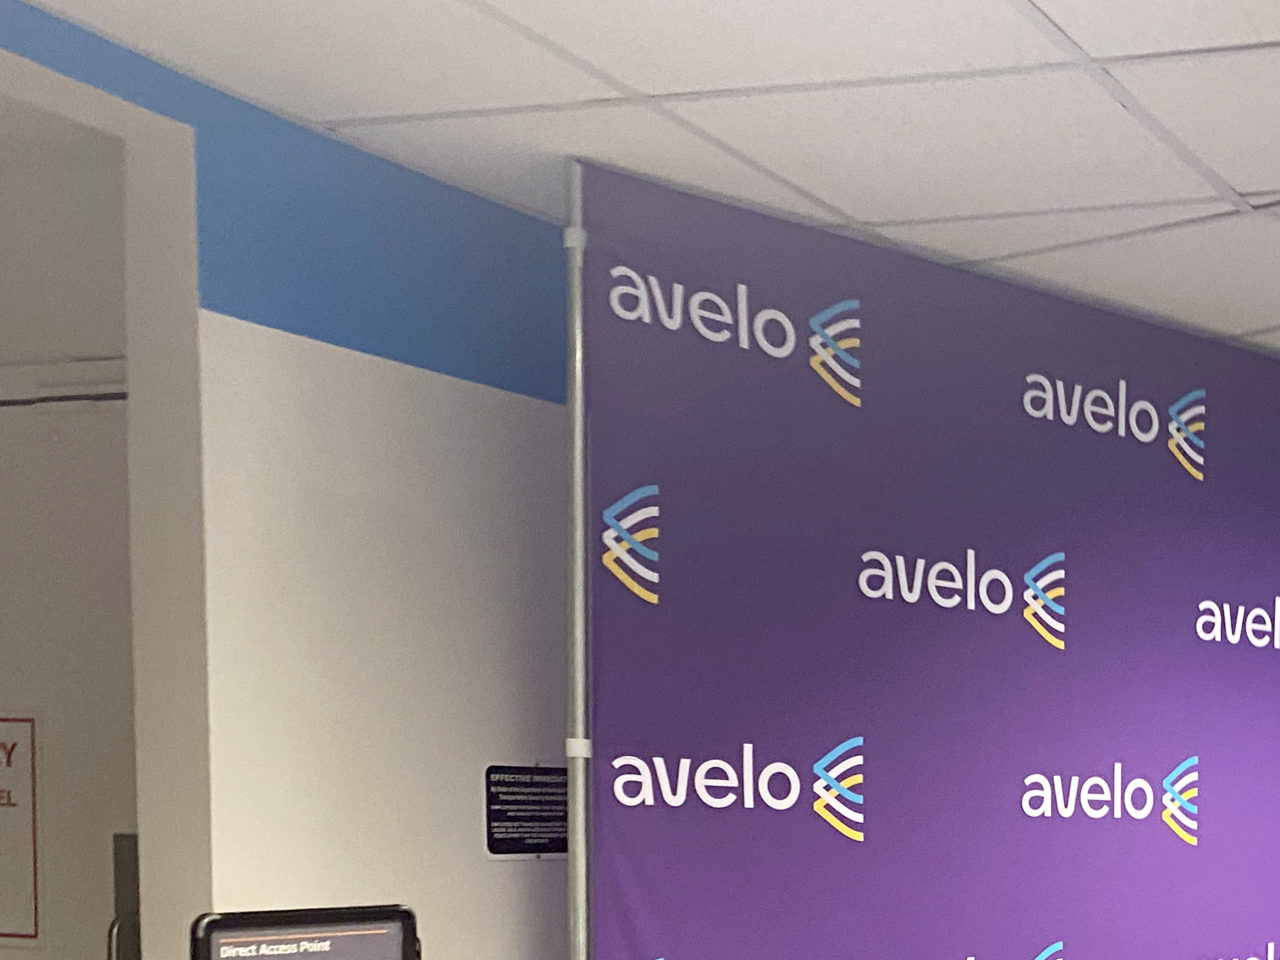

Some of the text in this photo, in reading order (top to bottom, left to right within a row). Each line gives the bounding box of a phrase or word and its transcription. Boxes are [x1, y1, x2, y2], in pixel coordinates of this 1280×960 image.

[609, 265, 796, 358] avelo
[1023, 374, 1159, 443] avelo
[858, 548, 1014, 614] avelo
[611, 743, 801, 811] avelo
[1021, 762, 1154, 820] avelo
[219, 940, 330, 958] Direct Access Point
